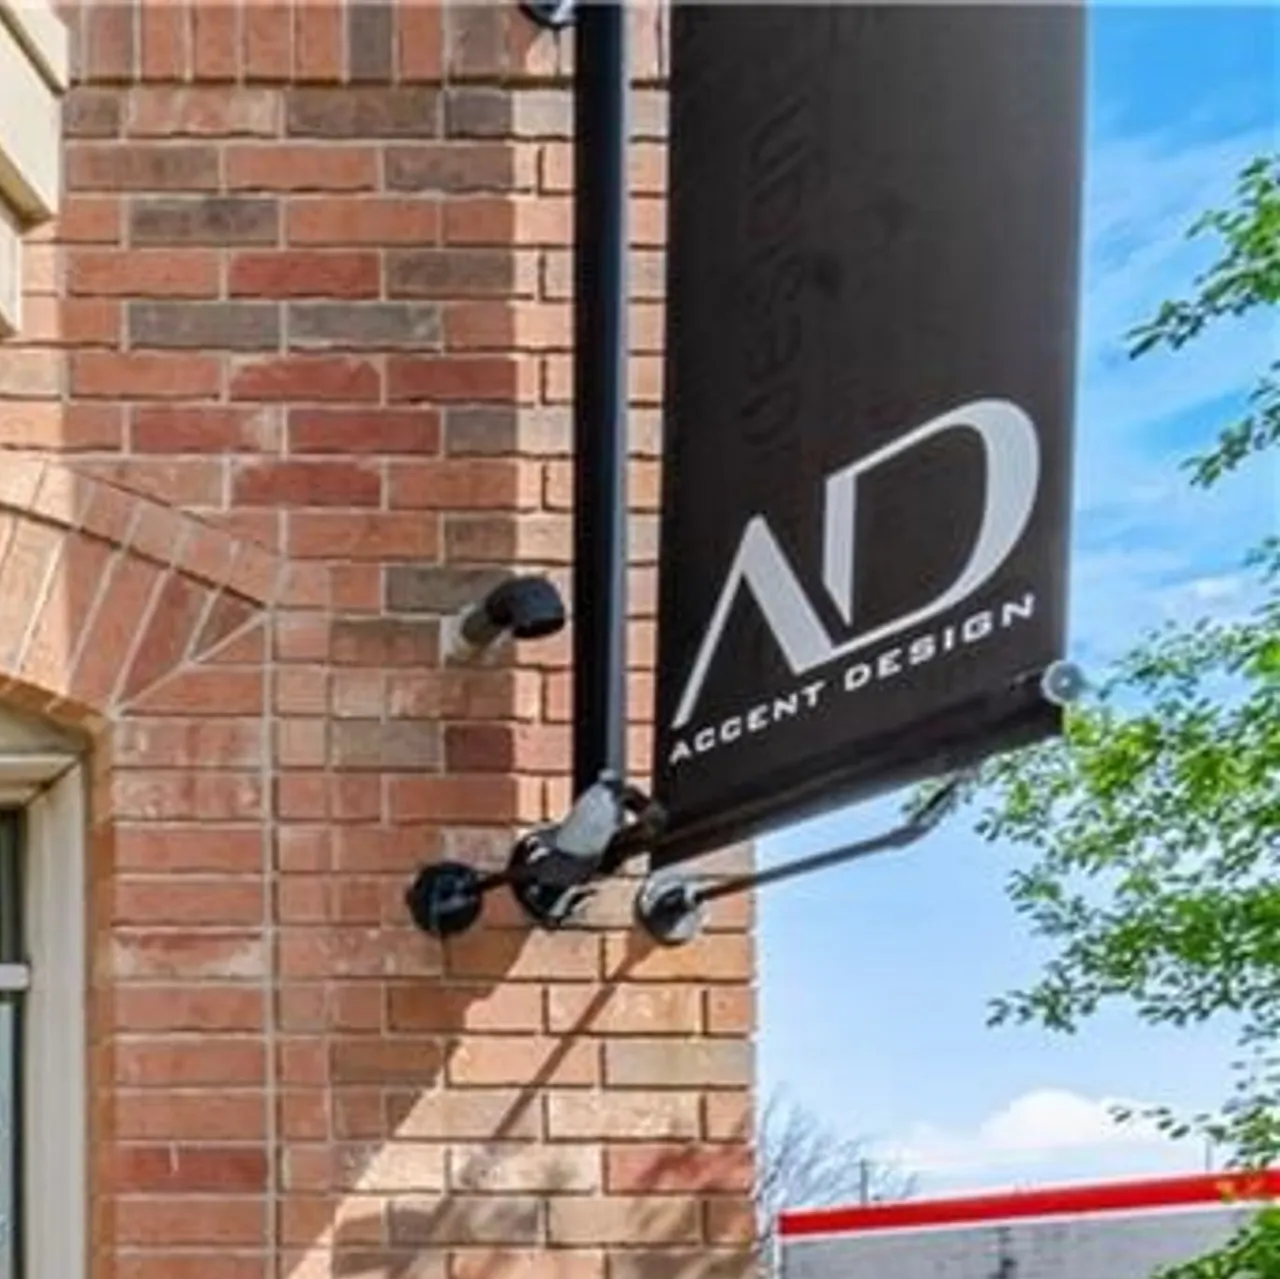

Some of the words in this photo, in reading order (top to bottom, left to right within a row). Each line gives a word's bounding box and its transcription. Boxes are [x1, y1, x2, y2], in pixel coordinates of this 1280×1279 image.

[669, 681, 826, 764] ACCENT
[844, 593, 1036, 693] DESIGN
[671, 399, 1040, 730] AD
